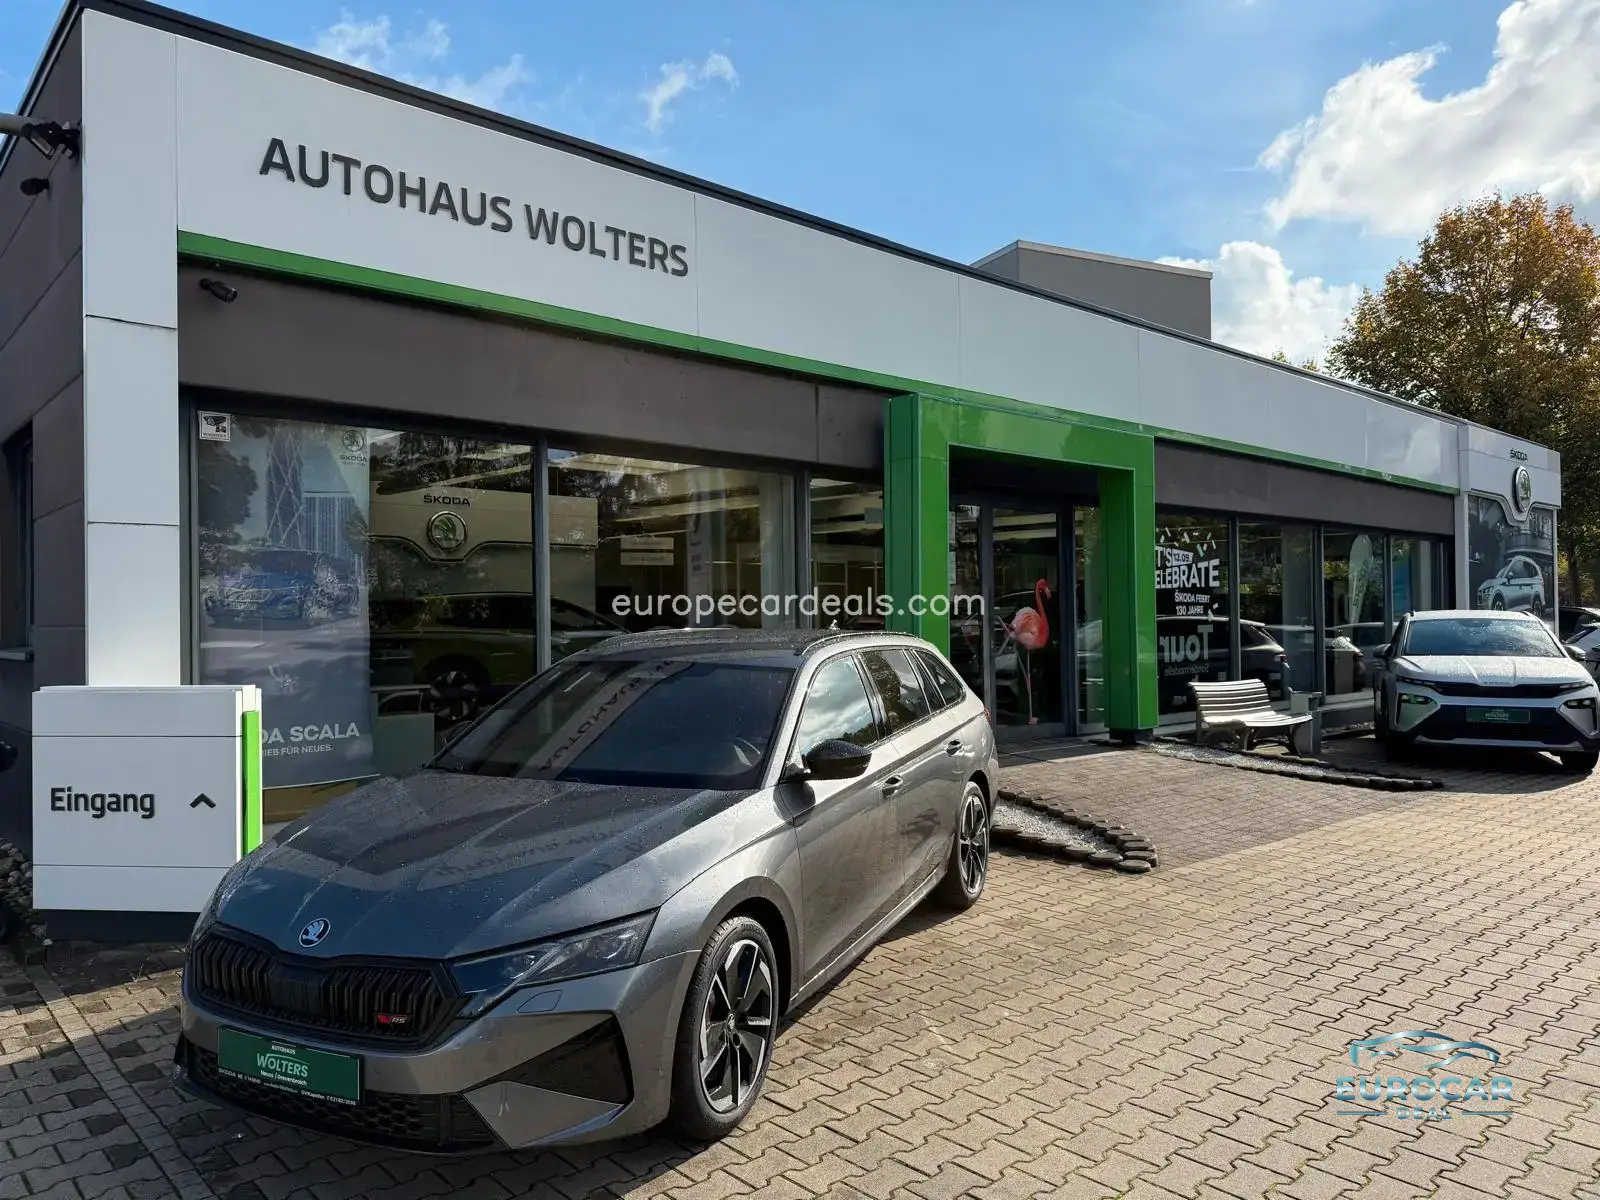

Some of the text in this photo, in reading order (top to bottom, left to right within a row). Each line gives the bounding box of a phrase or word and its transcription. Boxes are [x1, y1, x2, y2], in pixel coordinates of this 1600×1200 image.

[259, 137, 689, 277] AUTOHAUS WOLTERS
[1174, 589, 1195, 603] ŠKODA
[1175, 605, 1204, 616] 130 JAHRE
[289, 721, 360, 743] SCALA
[281, 745, 300, 756] FÜR
[301, 744, 334, 754] NEUES.
[50, 786, 155, 819] Eingang
[271, 1044, 296, 1055] AUTOHAUS
[256, 1052, 310, 1078] WOLTERS
